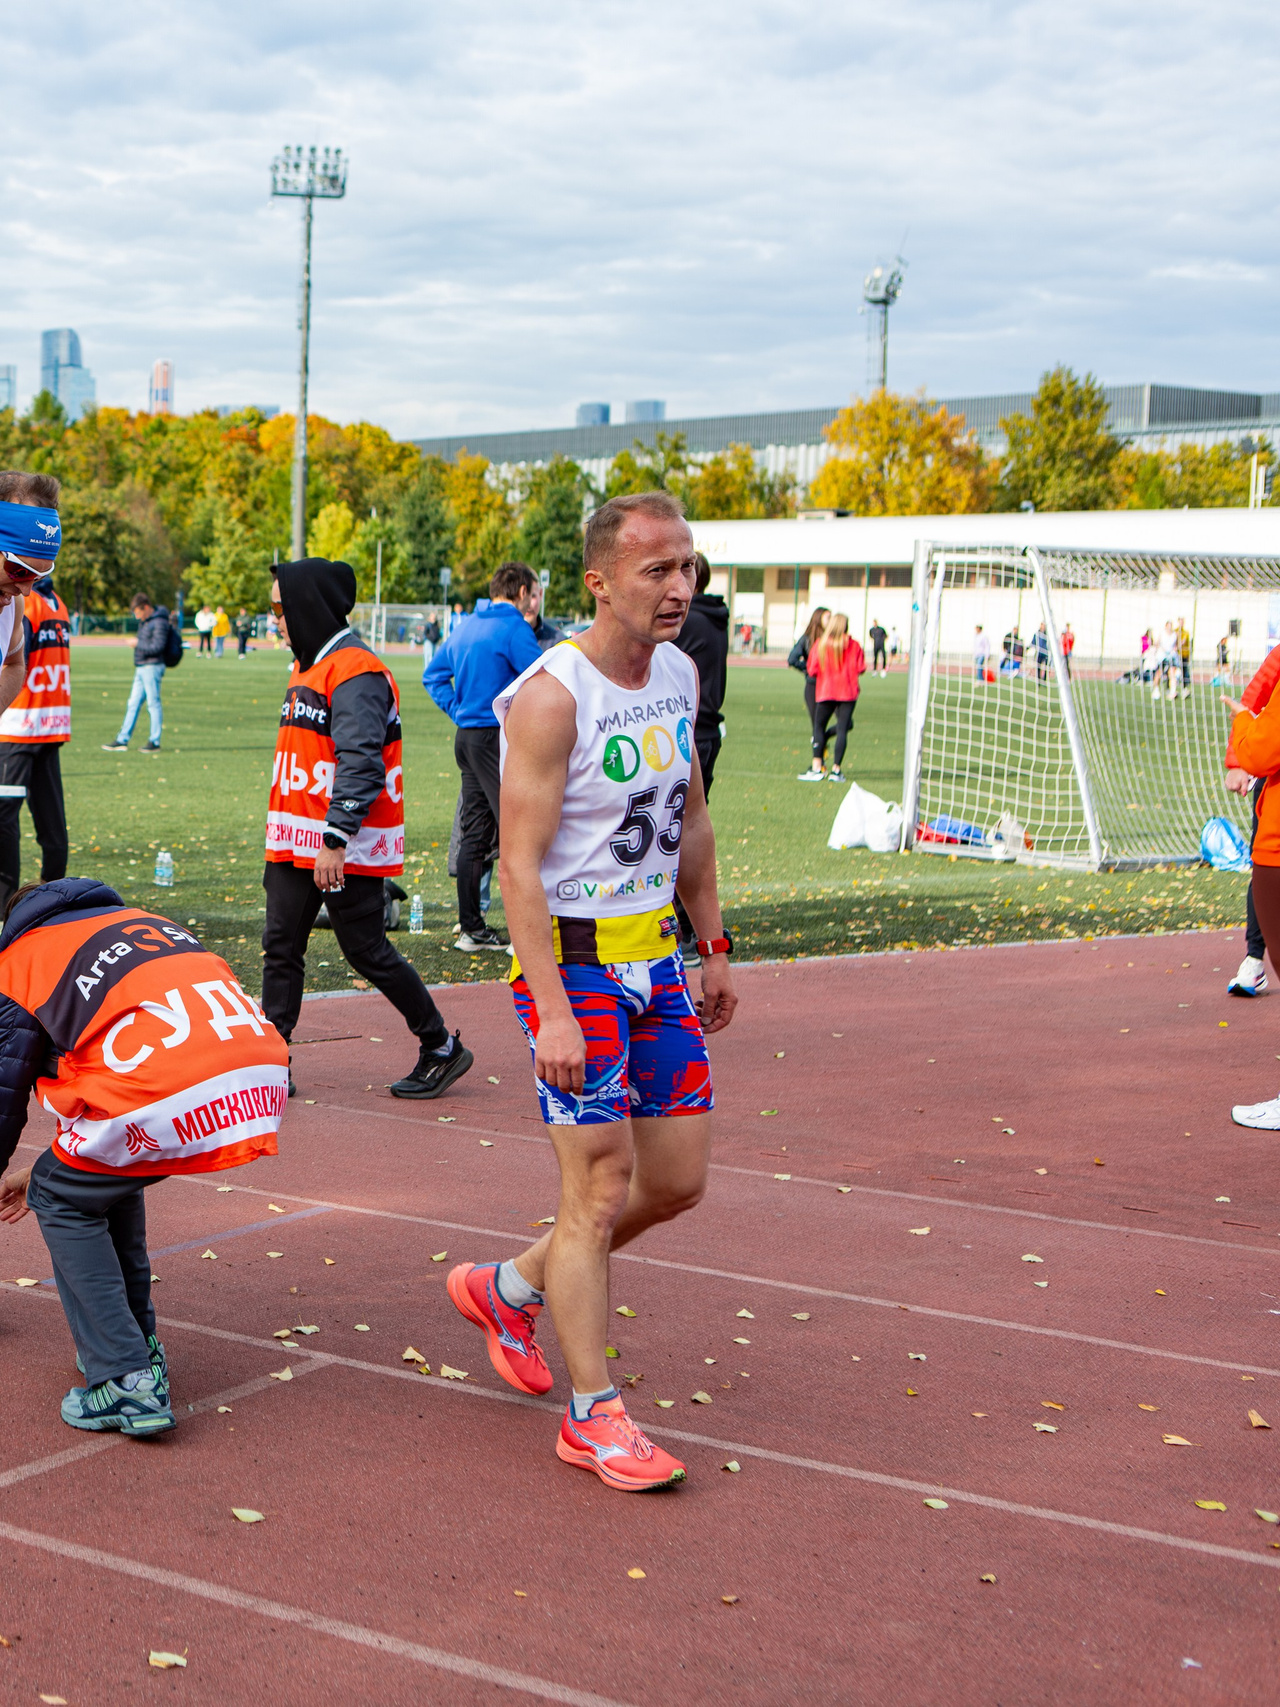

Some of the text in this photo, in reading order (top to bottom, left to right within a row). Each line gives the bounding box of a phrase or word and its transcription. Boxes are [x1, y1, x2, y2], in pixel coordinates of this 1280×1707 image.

[294, 699, 327, 724] port
[596, 695, 693, 733] VMARAFONE
[294, 828, 323, 850] СПО
[610, 778, 691, 867] 53
[583, 870, 678, 898] VMARAFONE
[75, 941, 133, 1001] Arta
